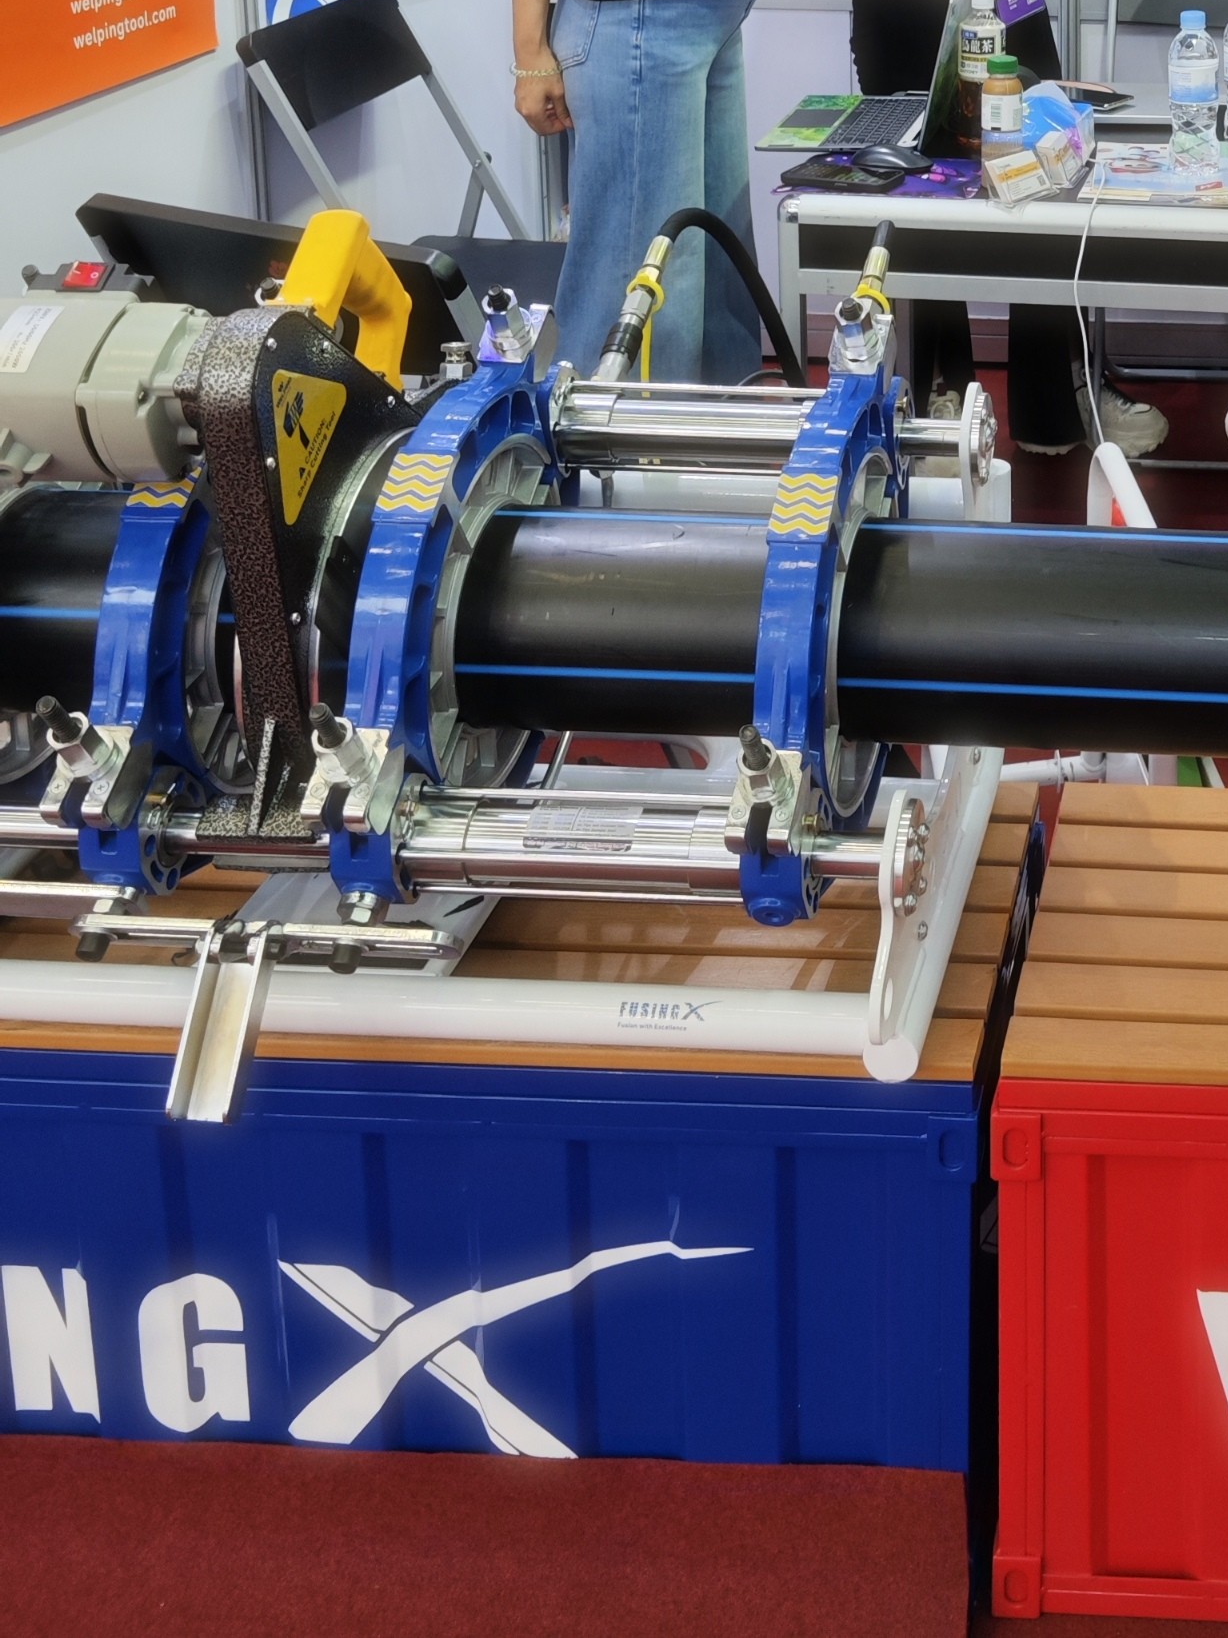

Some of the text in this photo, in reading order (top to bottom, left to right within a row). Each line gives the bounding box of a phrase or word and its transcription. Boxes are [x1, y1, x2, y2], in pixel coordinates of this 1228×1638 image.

[73, 5, 176, 49] welpingtool.com
[297, 410, 336, 499] Sharp Cutting Tool
[304, 418, 326, 465] CAUTION:
[617, 1021, 638, 1029] Fusion
[654, 1023, 687, 1031] Excellence
[619, 1000, 722, 1022] FUSINGX
